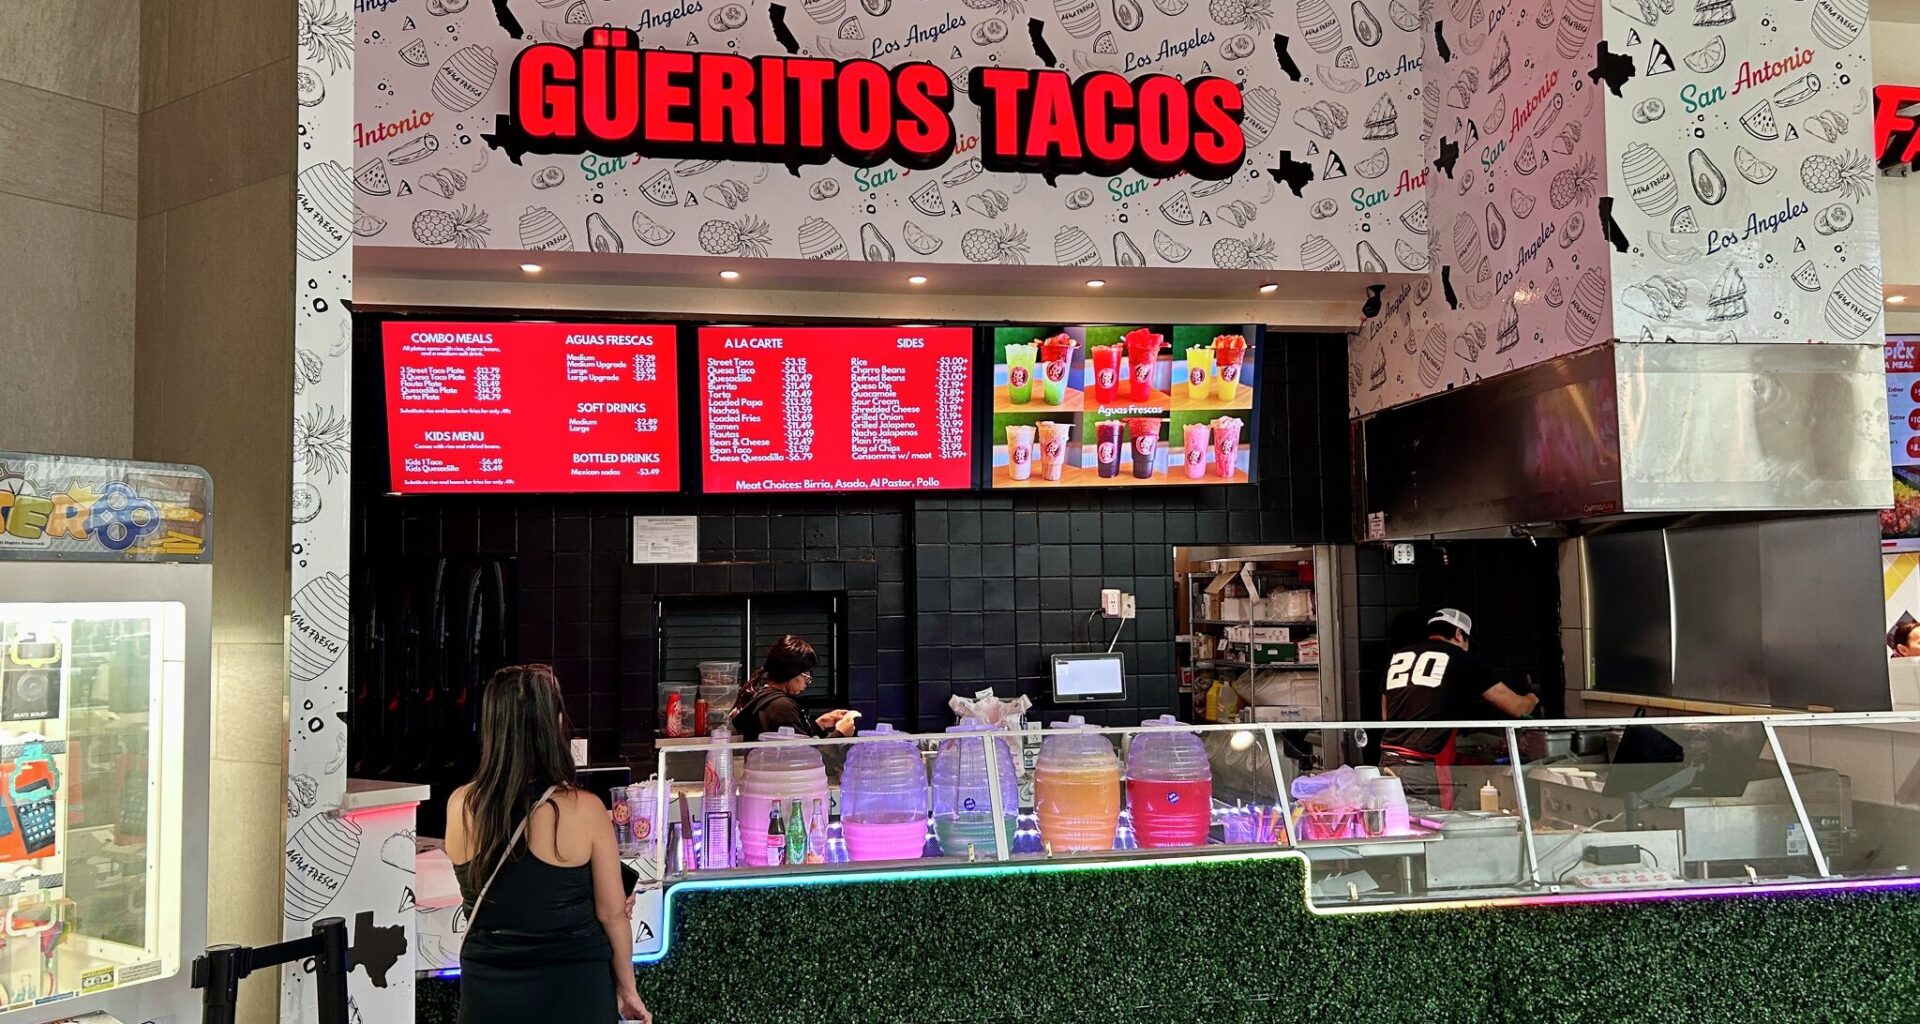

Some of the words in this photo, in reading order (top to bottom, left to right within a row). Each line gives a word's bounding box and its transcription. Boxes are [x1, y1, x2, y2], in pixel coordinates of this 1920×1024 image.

[871, 37, 900, 60] Los
[903, 12, 966, 48] Angeles
[1123, 51, 1152, 73] Los
[1155, 28, 1215, 62] Angeles
[1365, 67, 1391, 87] Los
[1680, 83, 1727, 113] San
[1732, 47, 1815, 96] Antonio
[518, 28, 951, 153] GÜERITOS
[983, 68, 1245, 165] TACOS
[1481, 139, 1507, 173] San
[1509, 69, 1560, 143] Antonio
[354, 110, 434, 148] Antonio
[580, 154, 627, 181] San
[854, 167, 898, 193] San
[1107, 177, 1149, 202] San
[1351, 187, 1390, 212] San
[313, 211, 343, 241] FRESCA
[1706, 230, 1738, 256] Los
[1742, 197, 1809, 240] Angeles
[1494, 269, 1514, 296] Los
[1515, 222, 1556, 274] Angeles
[1849, 304, 1872, 323] FRESCA
[411, 333, 454, 343] COMBO
[456, 333, 493, 344] MEALS
[565, 335, 604, 345] AGUAS
[606, 335, 653, 345] FRESCAS
[724, 338, 734, 348] A
[734, 338, 749, 348] LA
[750, 338, 783, 348] CARTE
[897, 338, 924, 348] SIDES
[1885, 346, 1915, 359] PICK
[596, 361, 627, 369] Upgrade
[708, 358, 732, 366] Street
[733, 358, 754, 366] Taco
[851, 357, 867, 366] Rice
[1892, 361, 1914, 369] MEAL
[707, 366, 734, 375] Quesa
[736, 366, 755, 374] Taco
[851, 366, 880, 374] Charro
[881, 366, 906, 374] Beans
[567, 374, 588, 382] Large
[589, 374, 620, 382] Upgrade
[708, 374, 752, 382] Quesadilla
[708, 382, 737, 390] Burrito
[851, 382, 876, 390] Queso
[878, 382, 892, 391] Dip
[401, 387, 438, 395] Quesadilla
[709, 390, 731, 398] Torta
[709, 398, 740, 406] Loaded
[741, 398, 763, 407] Papa
[851, 398, 870, 406] Sour
[577, 403, 604, 413] SOFT
[606, 403, 646, 413] DRINKS
[709, 406, 739, 414] Nachos
[892, 405, 920, 413] Cheese
[1097, 405, 1127, 416] Aguas
[1128, 405, 1163, 414] Frescas
[709, 414, 740, 422] Loaded
[741, 414, 761, 422] Fries
[851, 413, 878, 421] Grilled
[879, 413, 904, 421] Onion
[569, 425, 590, 433] Large
[851, 421, 878, 429] Grilled
[425, 432, 451, 441] KIDS
[452, 432, 484, 441] MENU
[710, 430, 739, 438] Flautas
[851, 429, 877, 437] Nacho
[710, 438, 731, 446] Bean
[732, 438, 740, 446] &
[741, 438, 770, 446] Cheese
[710, 446, 731, 454] Bean
[732, 446, 752, 454] Taco
[852, 445, 867, 453] Bag
[879, 444, 900, 453] Chips
[573, 454, 618, 463] BOTTLED
[620, 454, 660, 463] DRINKS
[710, 454, 740, 462] Cheese
[741, 453, 784, 463] Quesadilla
[898, 451, 910, 459] w/
[736, 481, 761, 490] Meat
[762, 480, 801, 489] Choices:
[804, 479, 833, 489] Birria,
[835, 479, 868, 489] Asada,
[870, 478, 880, 487] Al
[882, 478, 915, 488] Pastor,
[917, 477, 940, 487] Pollo
[307, 628, 339, 654] FRESCA
[1386, 651, 1450, 691] 20
[286, 849, 309, 872] AGUA
[307, 866, 338, 890] FRESCA
